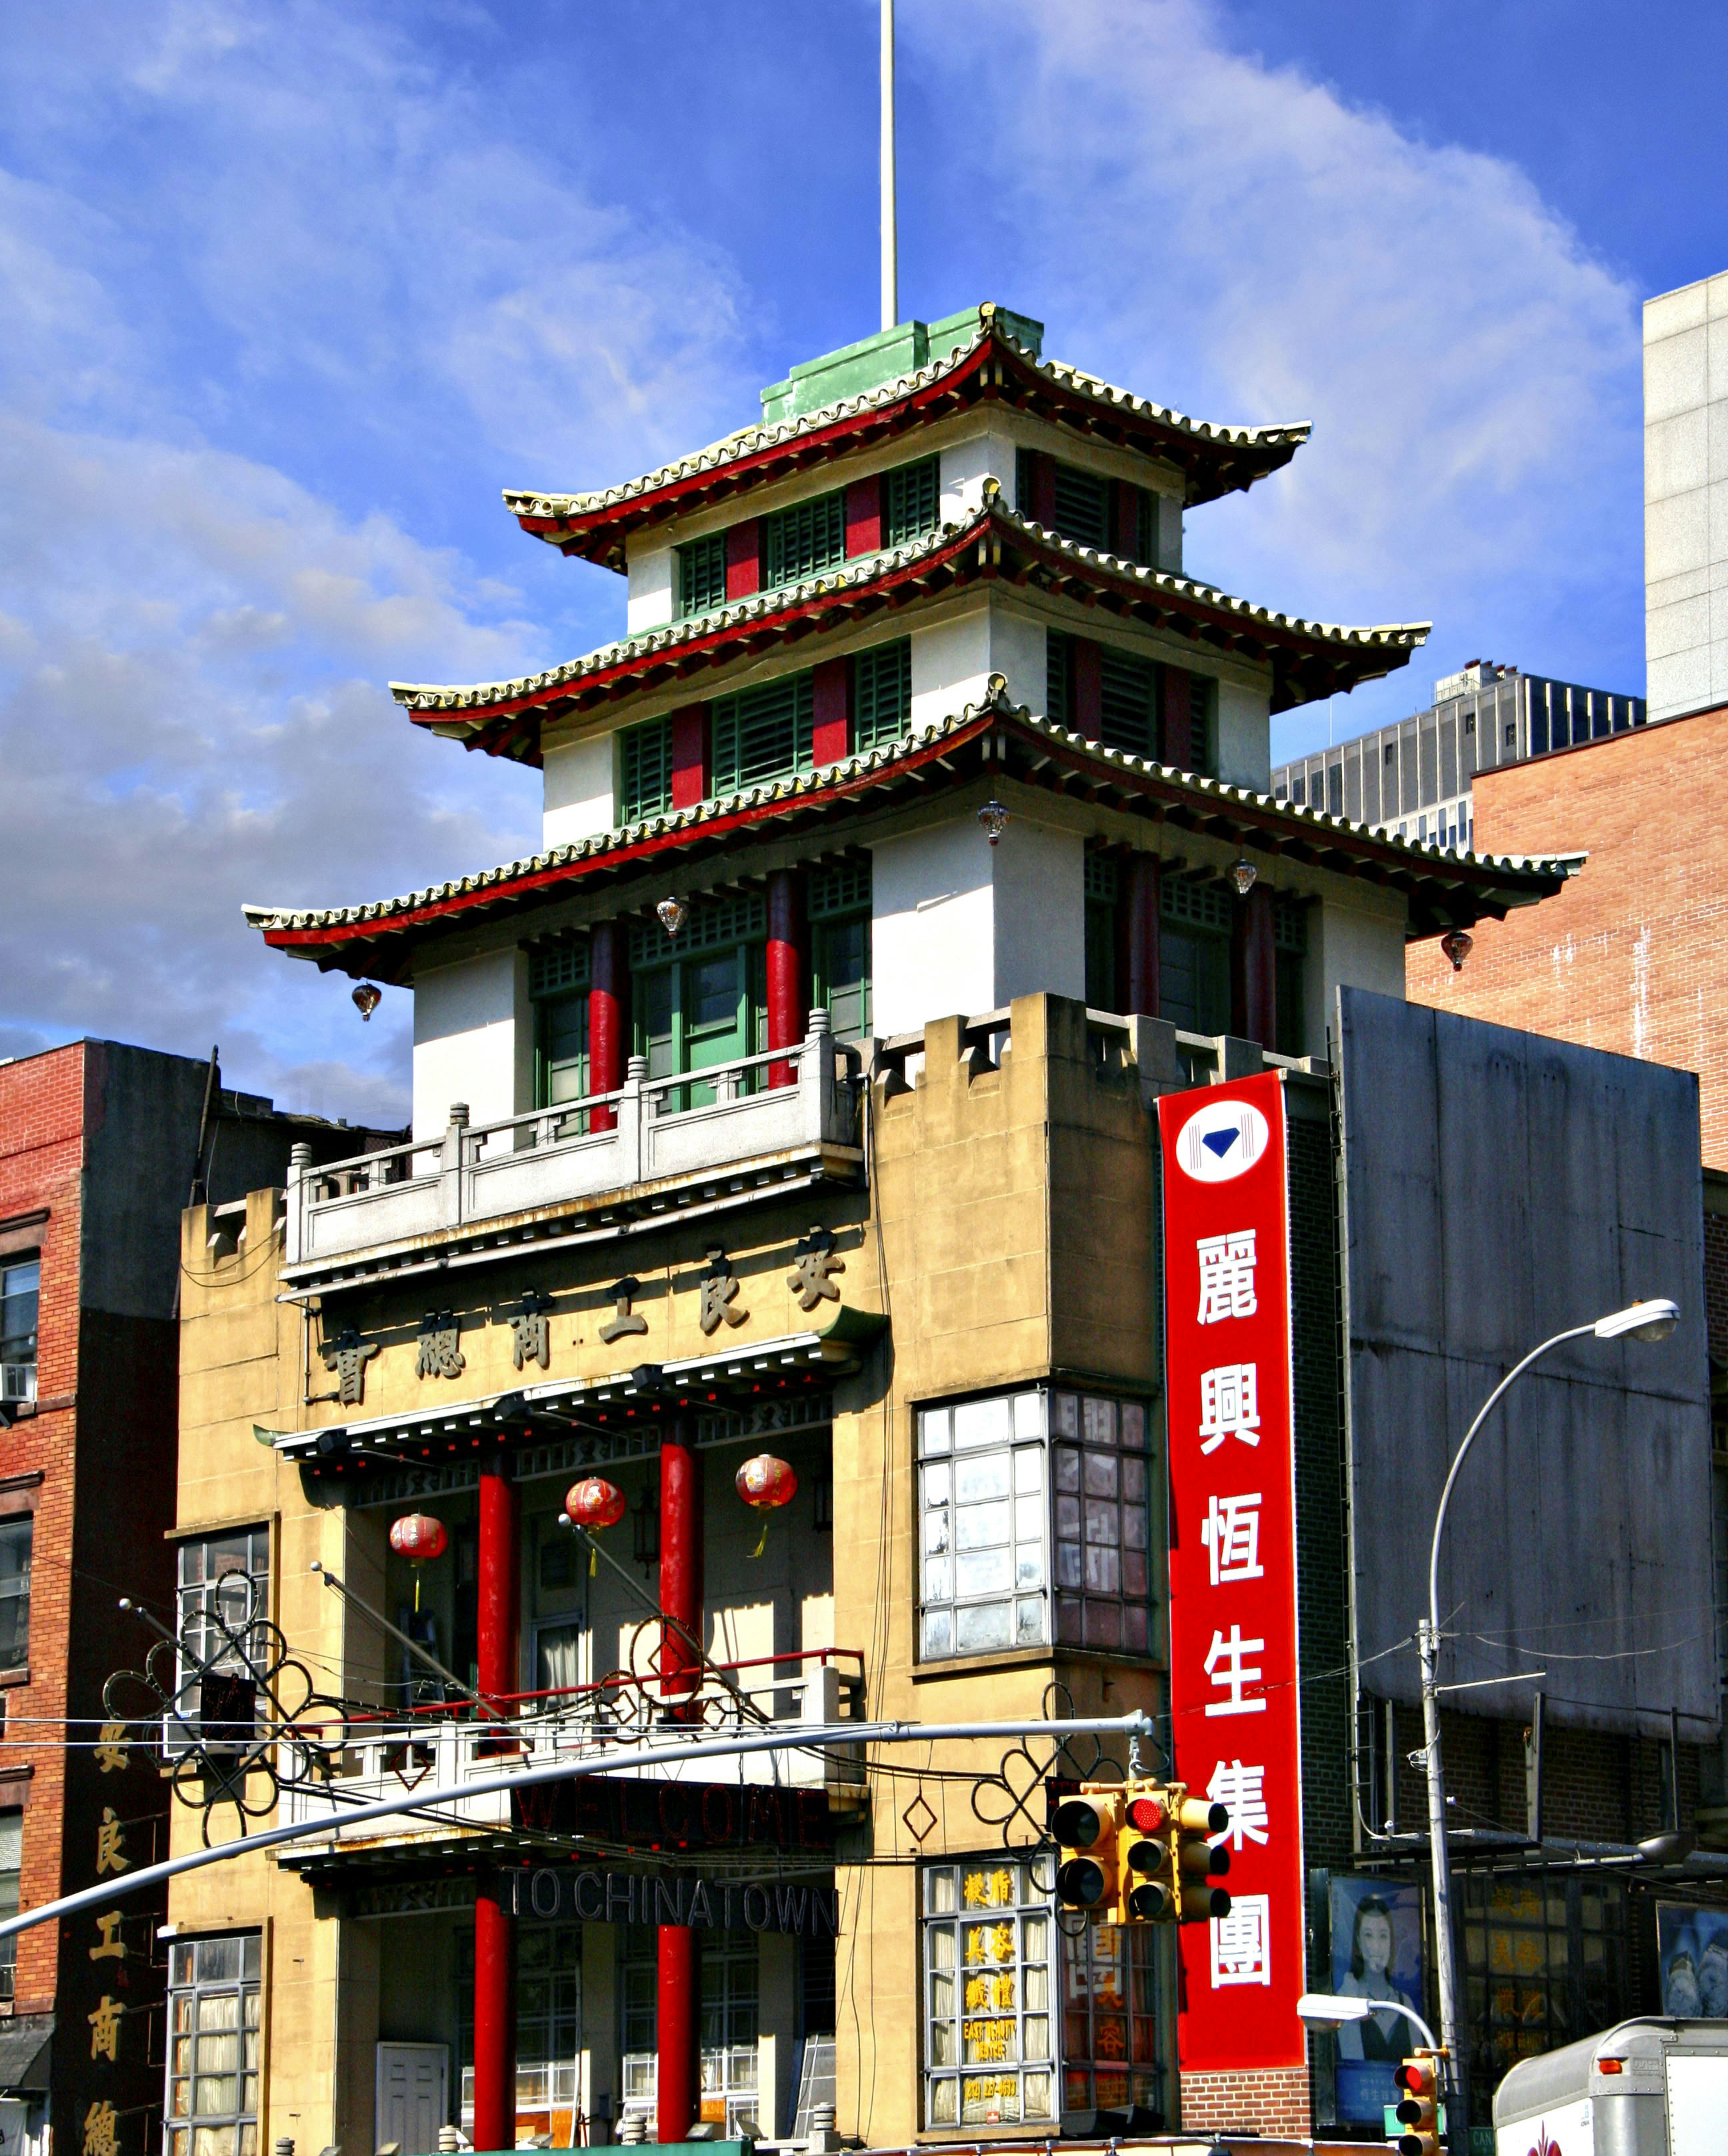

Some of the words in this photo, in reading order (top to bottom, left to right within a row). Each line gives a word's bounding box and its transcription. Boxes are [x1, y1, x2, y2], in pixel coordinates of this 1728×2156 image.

[514, 1775, 830, 1849] WELCOME
[501, 1866, 561, 1918] TO
[573, 1870, 839, 1937] CHINATOWN
[965, 1924, 1015, 1963] 美容
[964, 2021, 983, 2039] EAST
[986, 2019, 1016, 2039] BEAUTY
[975, 2041, 1003, 2059] CENTER
